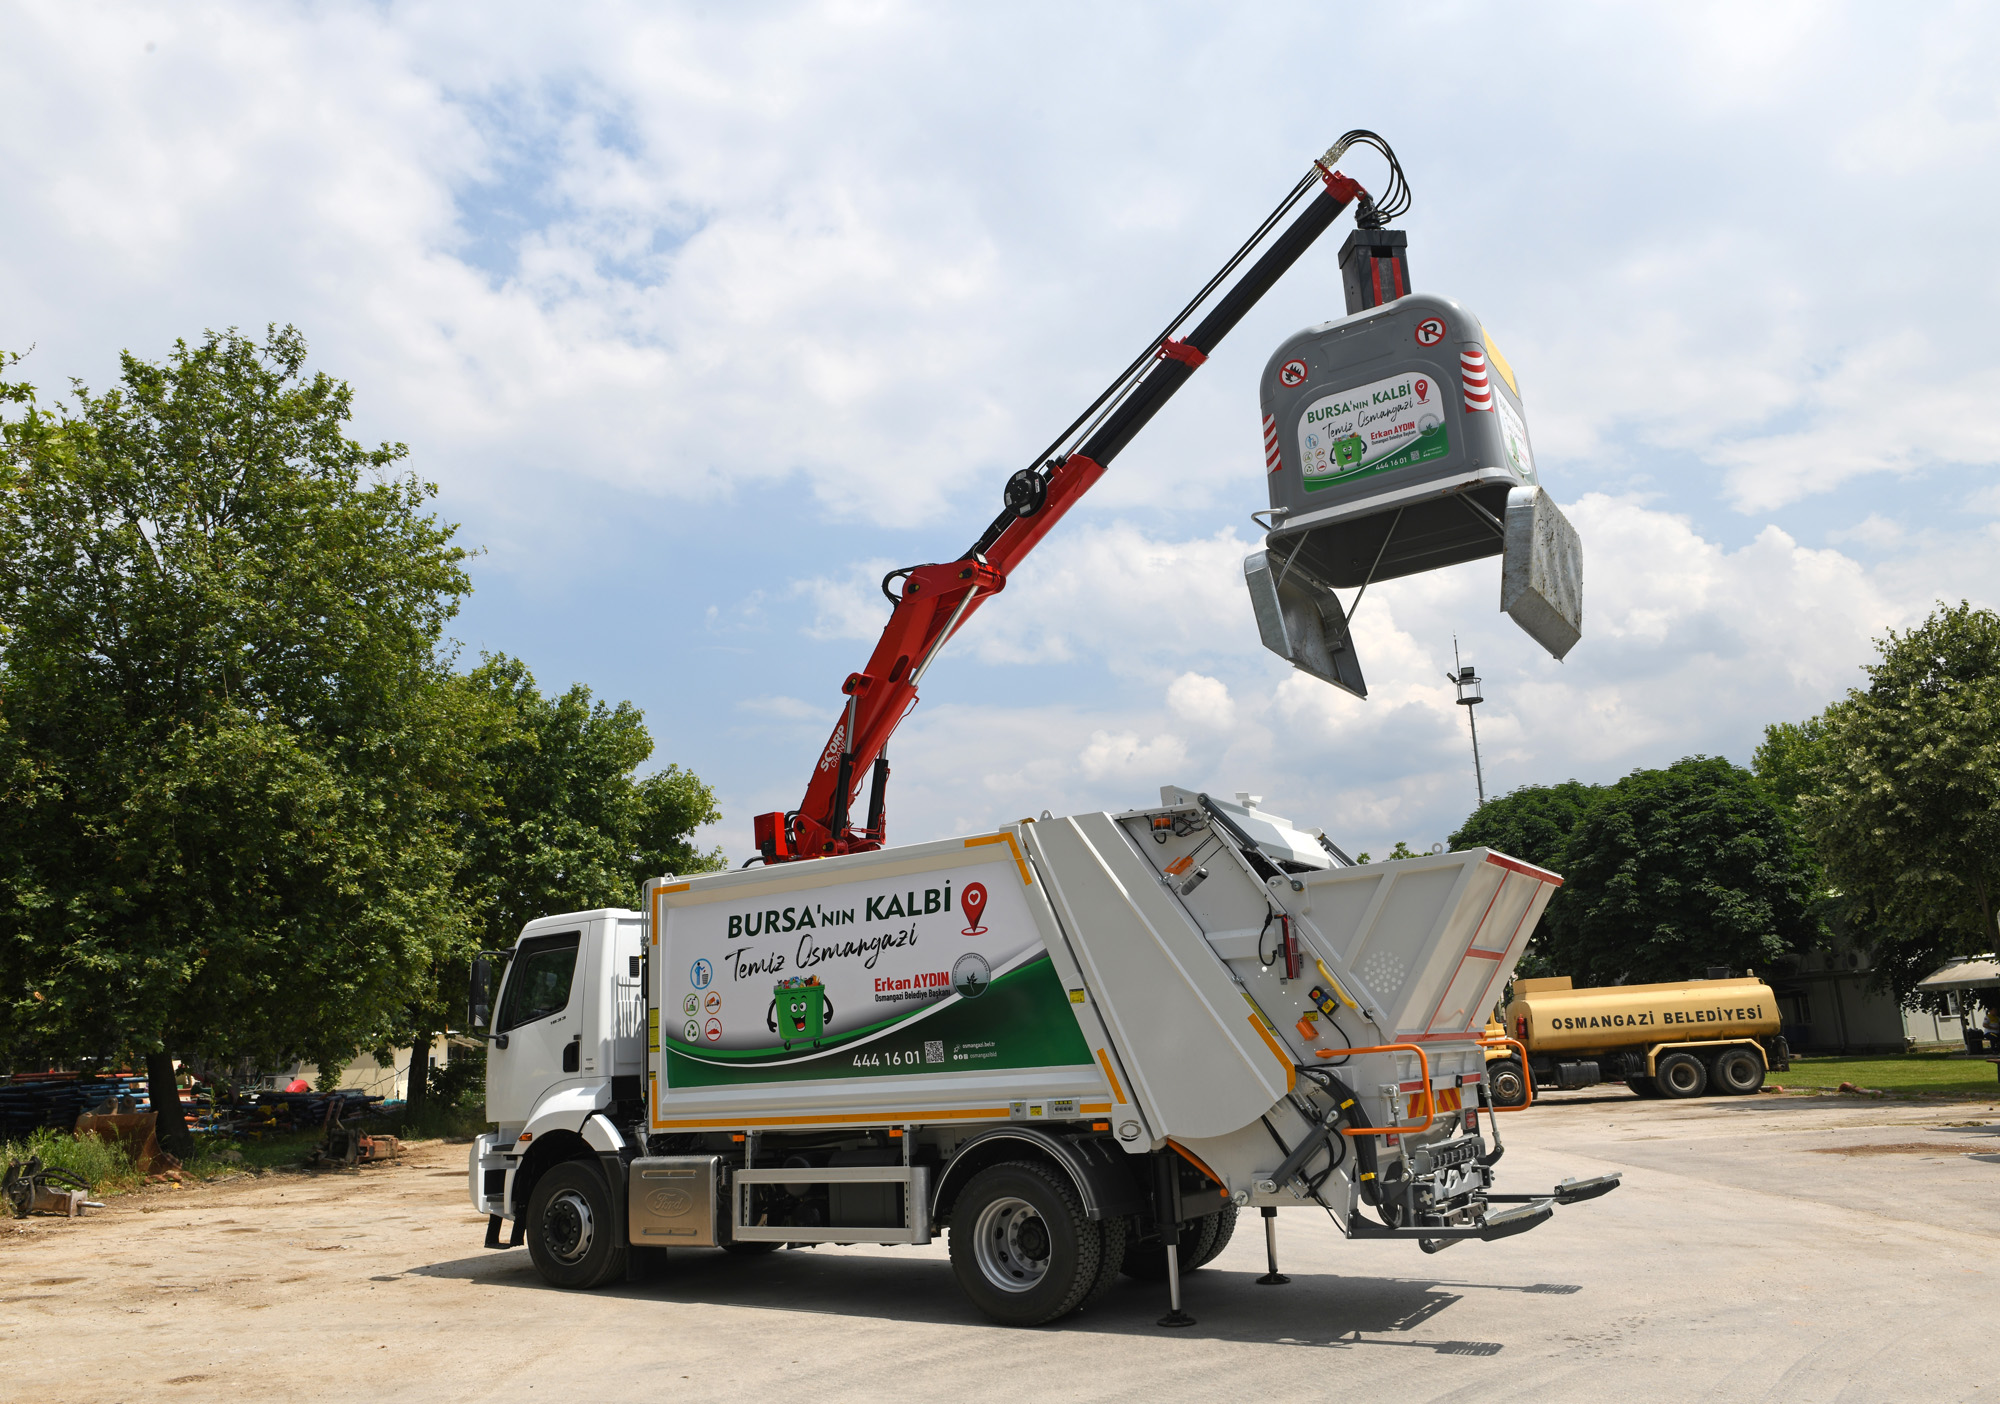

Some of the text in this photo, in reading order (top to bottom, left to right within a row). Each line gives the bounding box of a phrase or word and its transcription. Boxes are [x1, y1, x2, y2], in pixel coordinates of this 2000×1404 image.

[1307, 380, 1412, 424] BURSA'NIN KALBİ
[1322, 421, 1353, 440] Temiz
[1357, 397, 1414, 428] Osmangazi
[1370, 429, 1393, 440] Erkan
[1394, 421, 1415, 434] AYDIN
[1375, 456, 1407, 470] 444 16 01
[820, 724, 845, 772] SCORP
[727, 879, 951, 939] BURSA'NIN KALBİ
[724, 922, 919, 982] Temiz Osmangazi
[874, 977, 911, 992] Erkan
[913, 971, 950, 989] AYDIN
[874, 992, 904, 1003] Osmangazi
[904, 990, 928, 1000] Belediye
[1551, 1004, 1763, 1030] OSMANGAZİ BELEDİYESİ
[852, 1050, 920, 1067] 444 16 01
[655, 1193, 684, 1210] Ford
